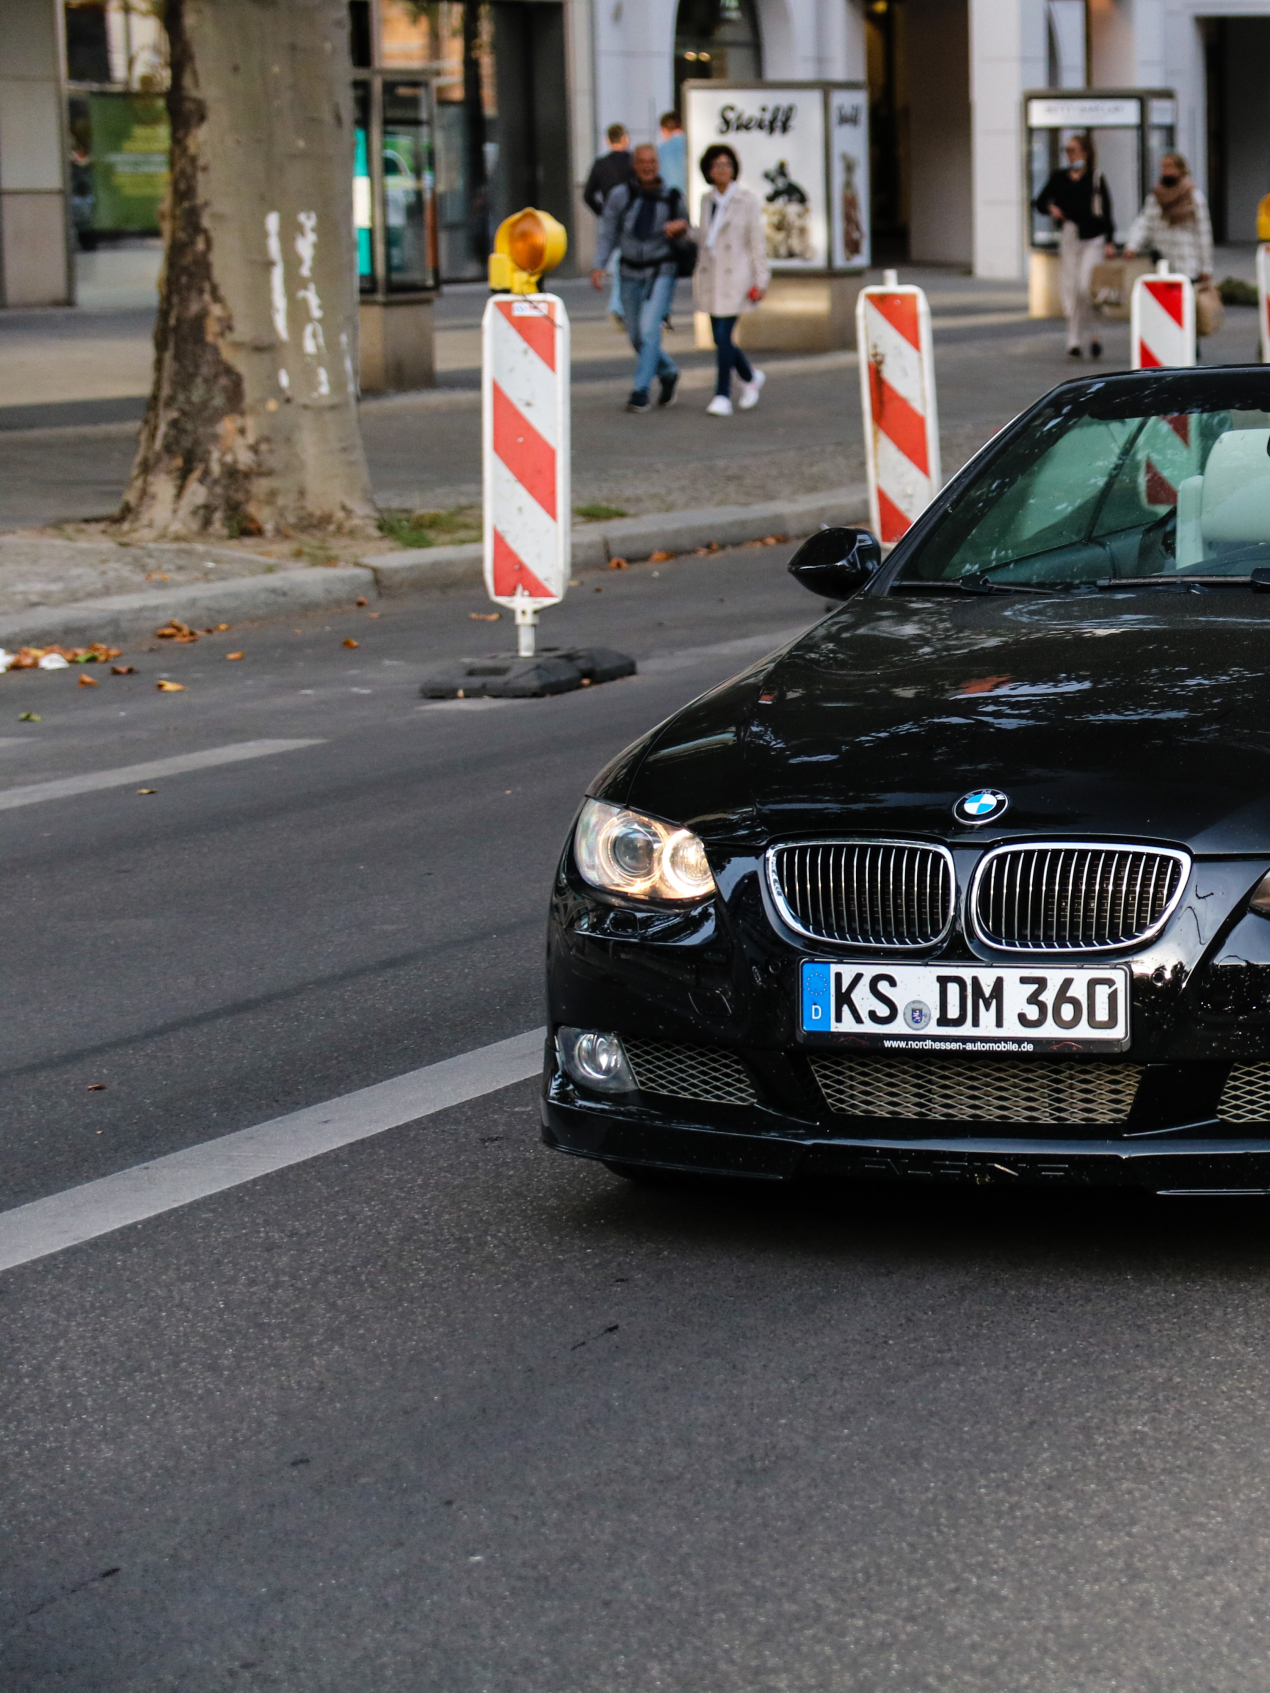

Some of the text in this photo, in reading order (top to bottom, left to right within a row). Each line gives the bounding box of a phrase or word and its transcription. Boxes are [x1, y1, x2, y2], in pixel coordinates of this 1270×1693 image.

[718, 104, 797, 135] Steiff
[834, 971, 1119, 1030] KS DM 360
[811, 1005, 822, 1020] D
[883, 1039, 1034, 1052] www.nordhessen-automobile.de
